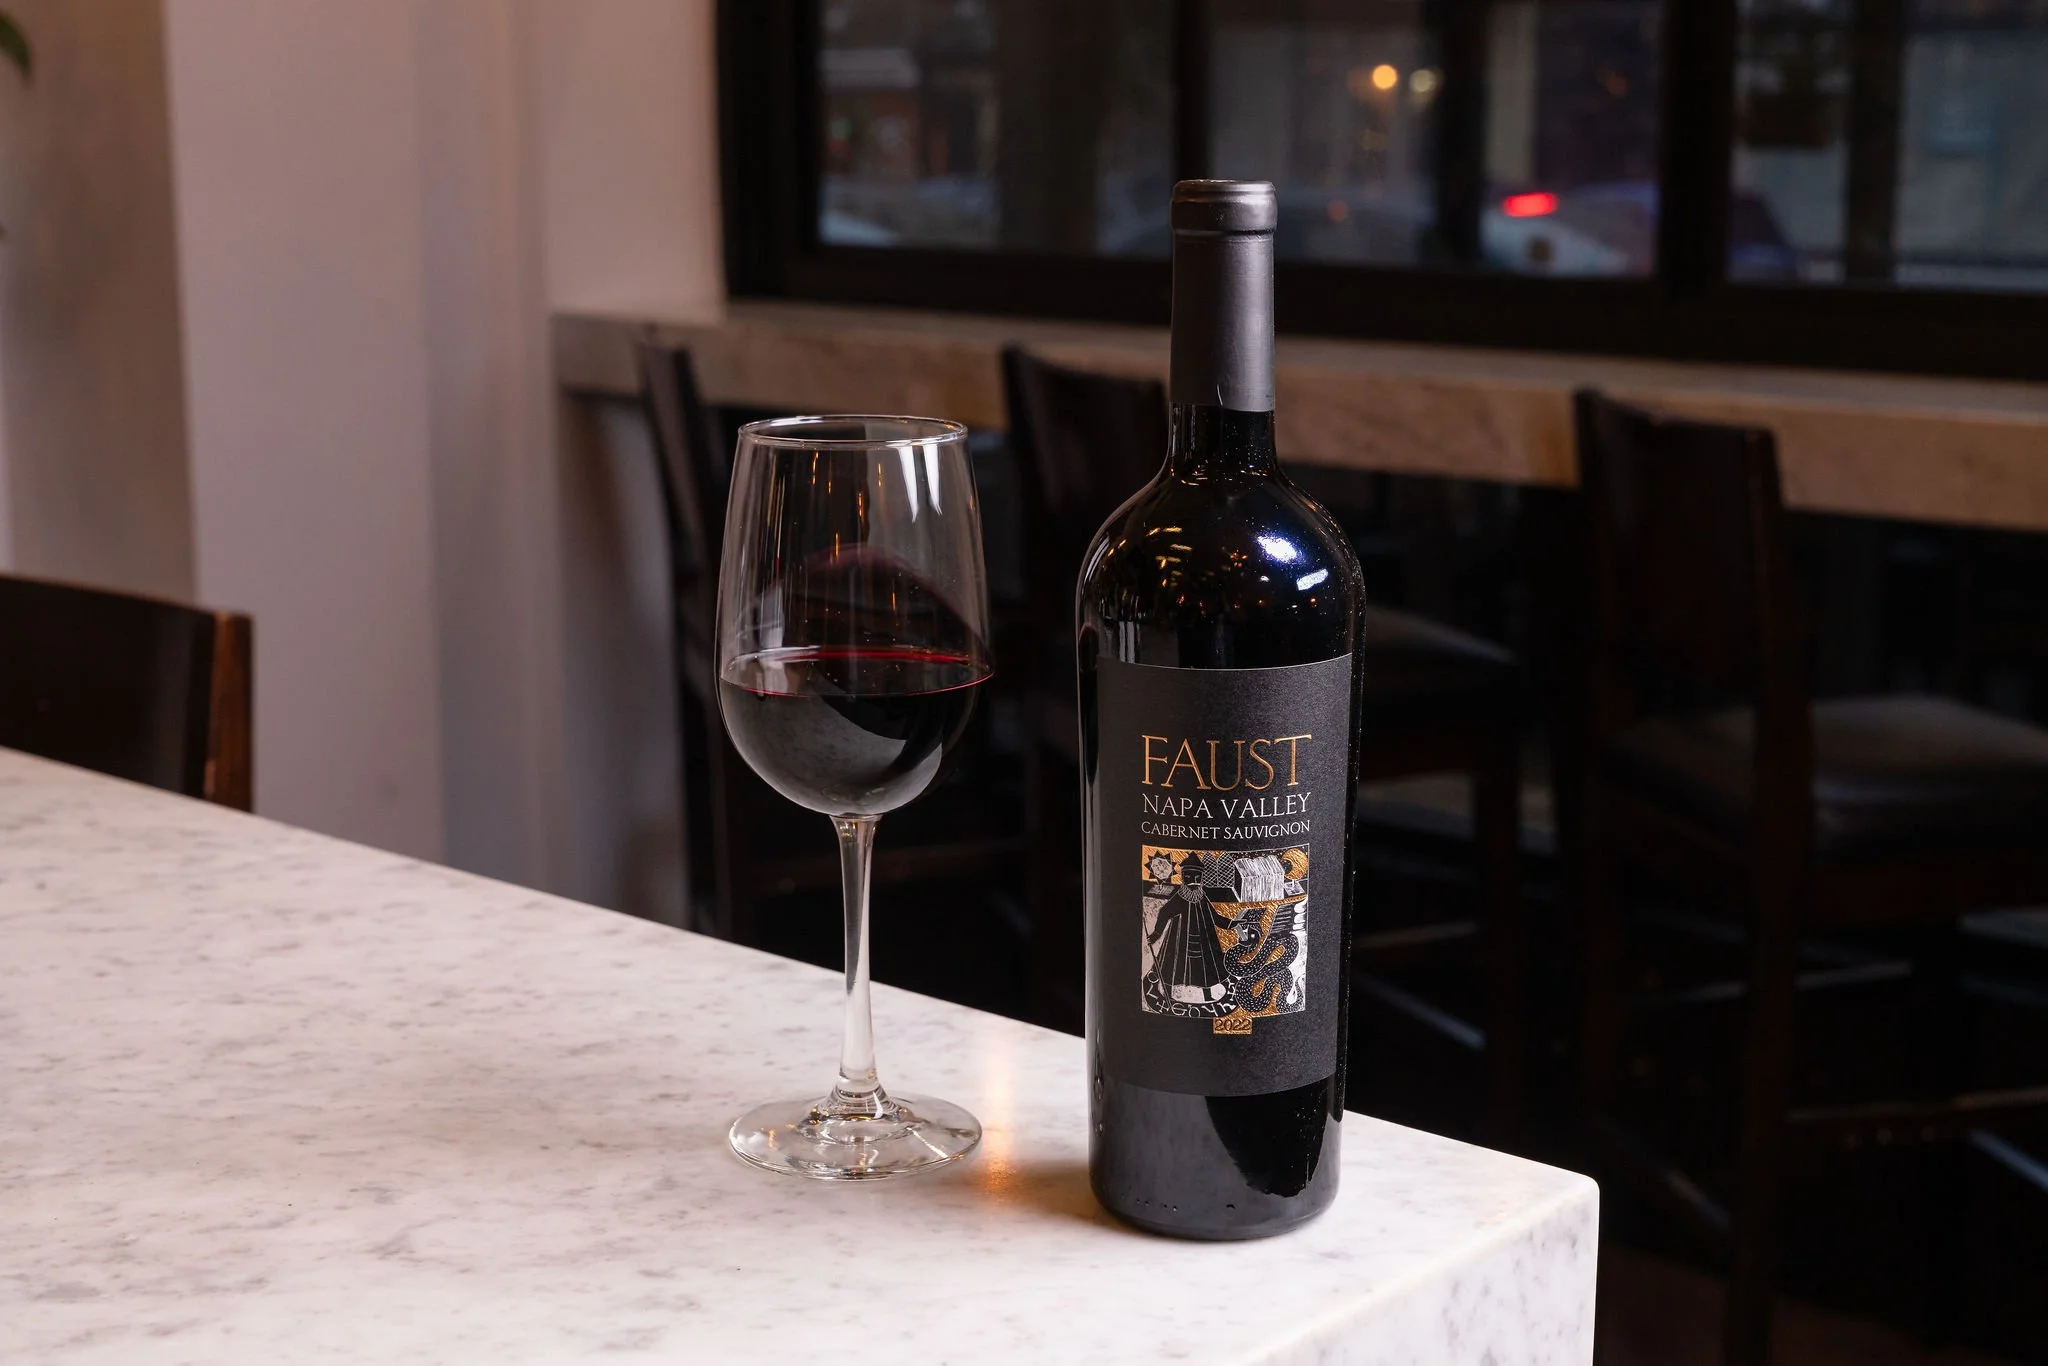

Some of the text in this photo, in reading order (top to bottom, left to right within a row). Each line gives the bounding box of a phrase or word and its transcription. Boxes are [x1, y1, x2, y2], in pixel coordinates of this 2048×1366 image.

[1141, 734, 1312, 791] FAUST
[1142, 792, 1311, 819] NAPA VALLEY
[1141, 820, 1310, 840] CABERNET SAUVIGNON
[1214, 1018, 1251, 1032] 2022
